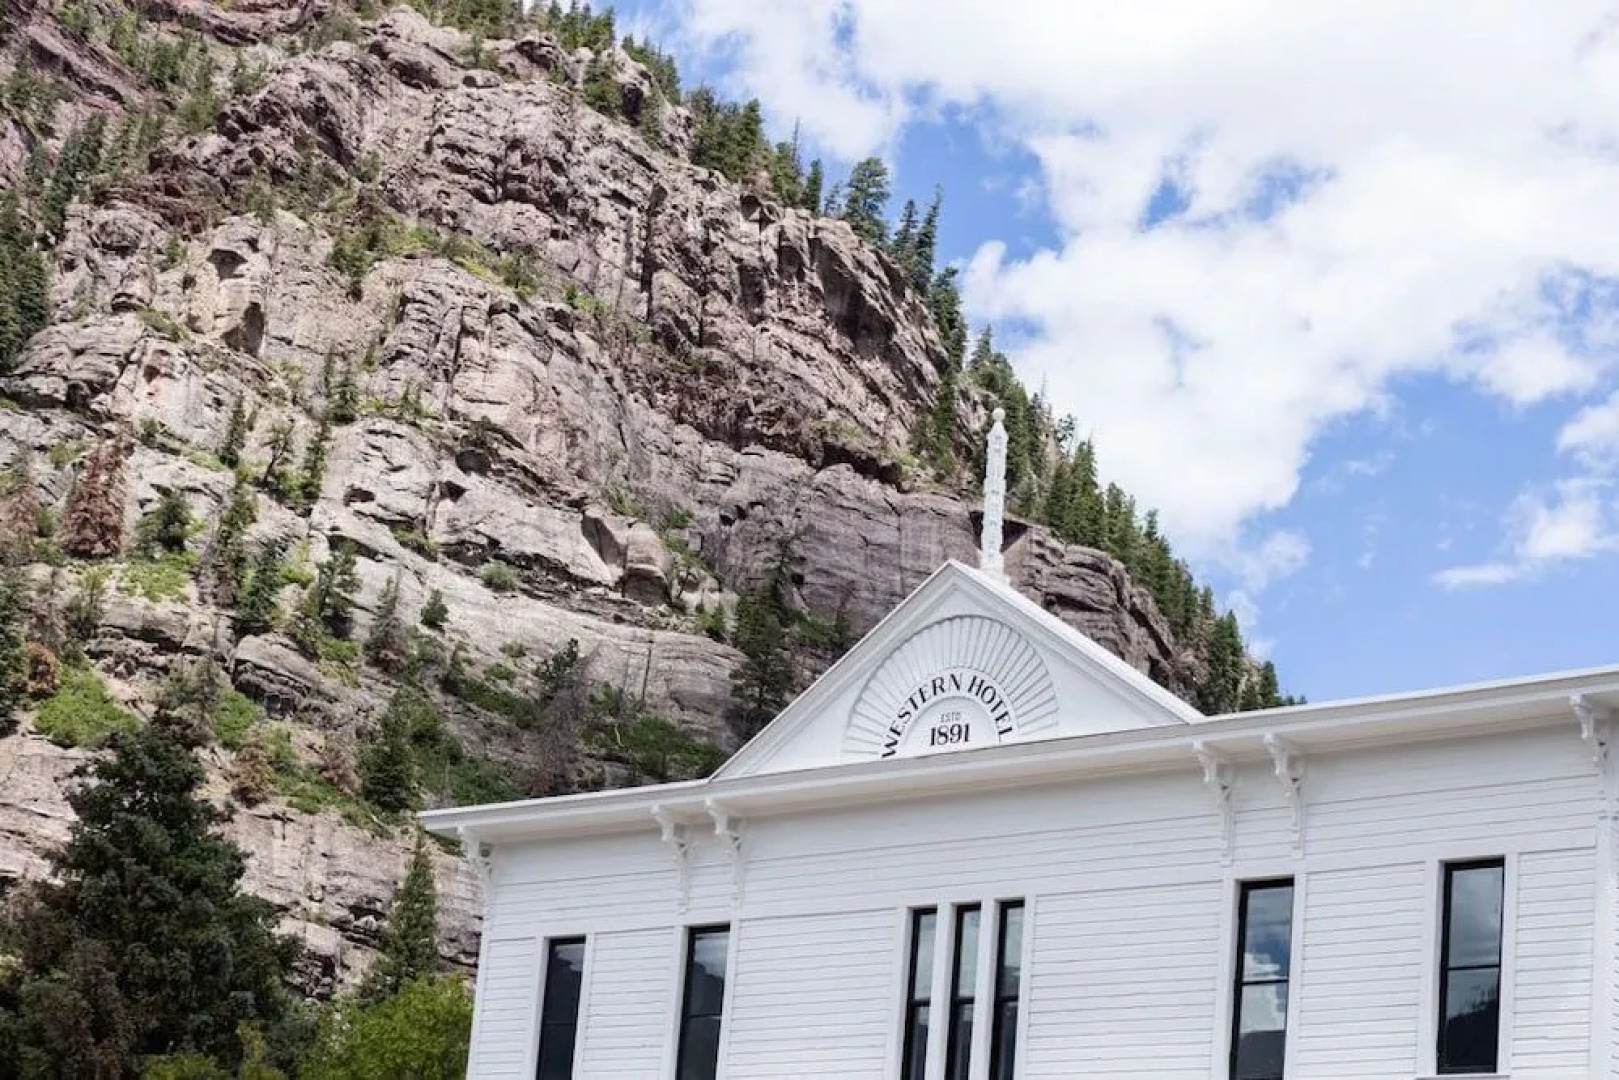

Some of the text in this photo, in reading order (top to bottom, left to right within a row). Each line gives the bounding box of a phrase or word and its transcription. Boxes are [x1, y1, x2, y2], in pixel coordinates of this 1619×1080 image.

[881, 673, 1013, 758] WESTERN HOTEL
[930, 723, 970, 746] 1891
